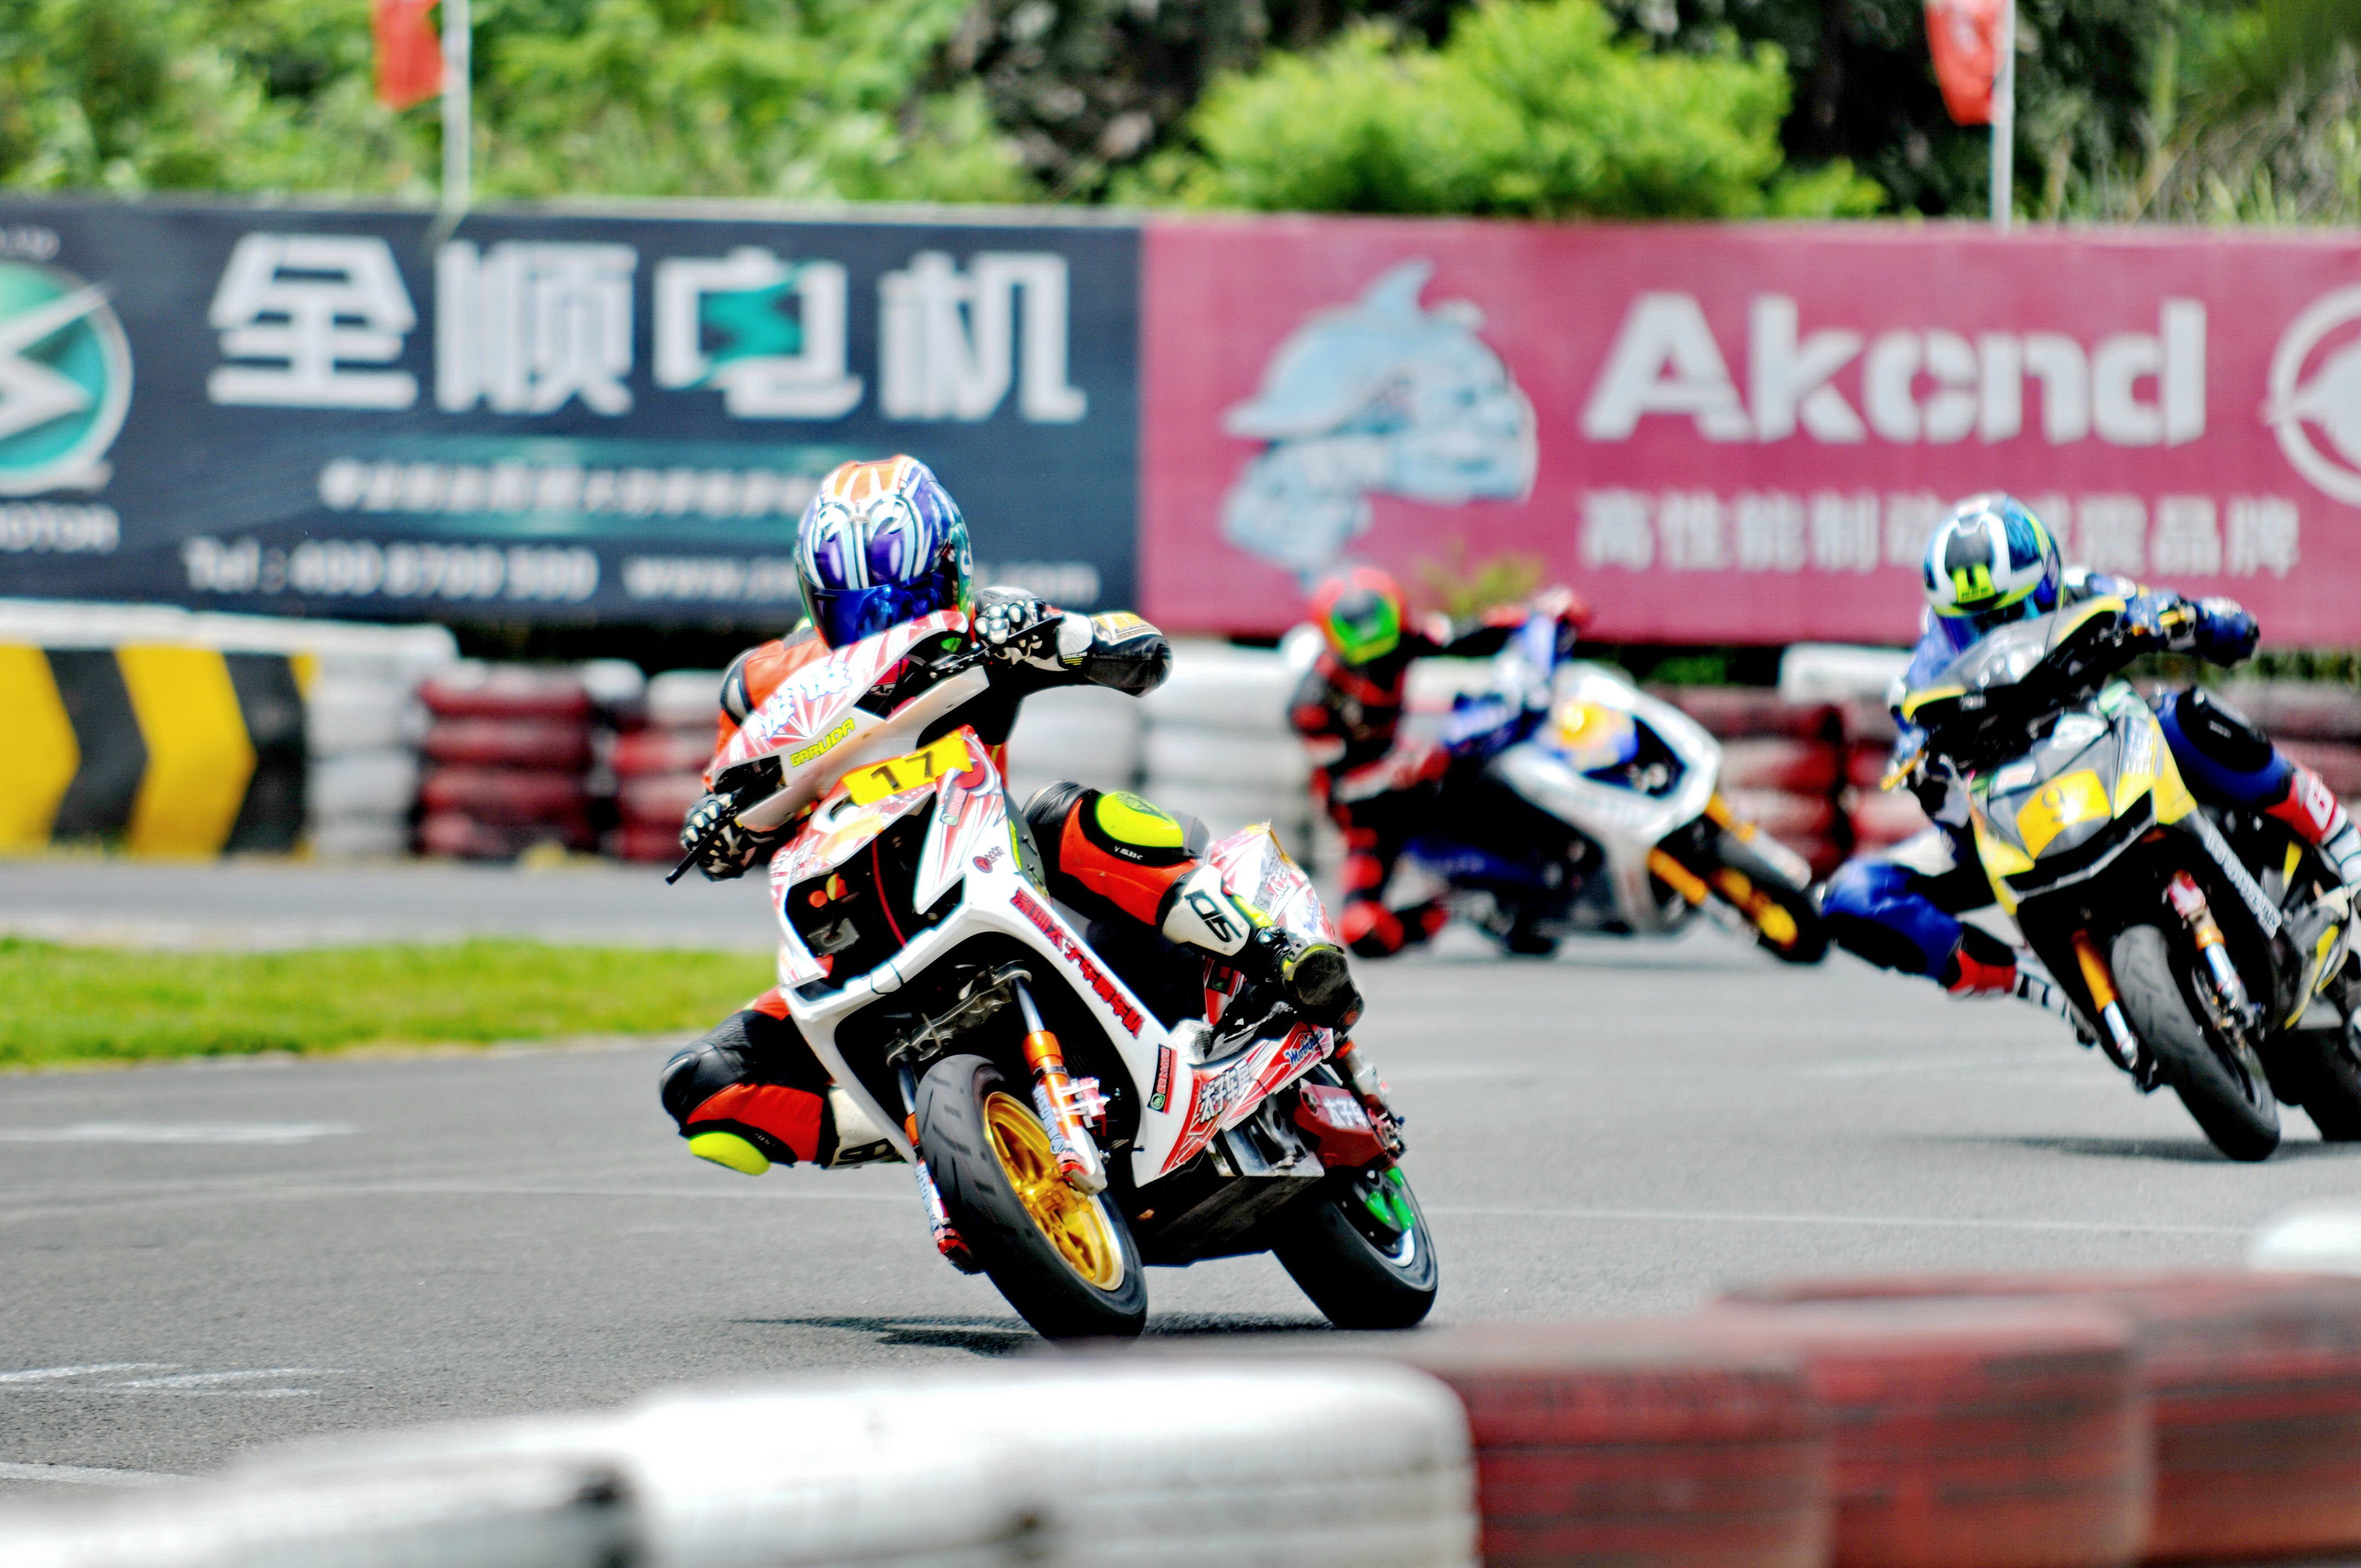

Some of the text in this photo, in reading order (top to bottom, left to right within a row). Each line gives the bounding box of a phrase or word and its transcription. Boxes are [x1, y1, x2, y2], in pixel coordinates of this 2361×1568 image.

[207, 231, 1088, 424] 全顺电机
[1581, 292, 2208, 447] Akcnd
[789, 717, 855, 767] GARUDA
[871, 751, 934, 792] 17
